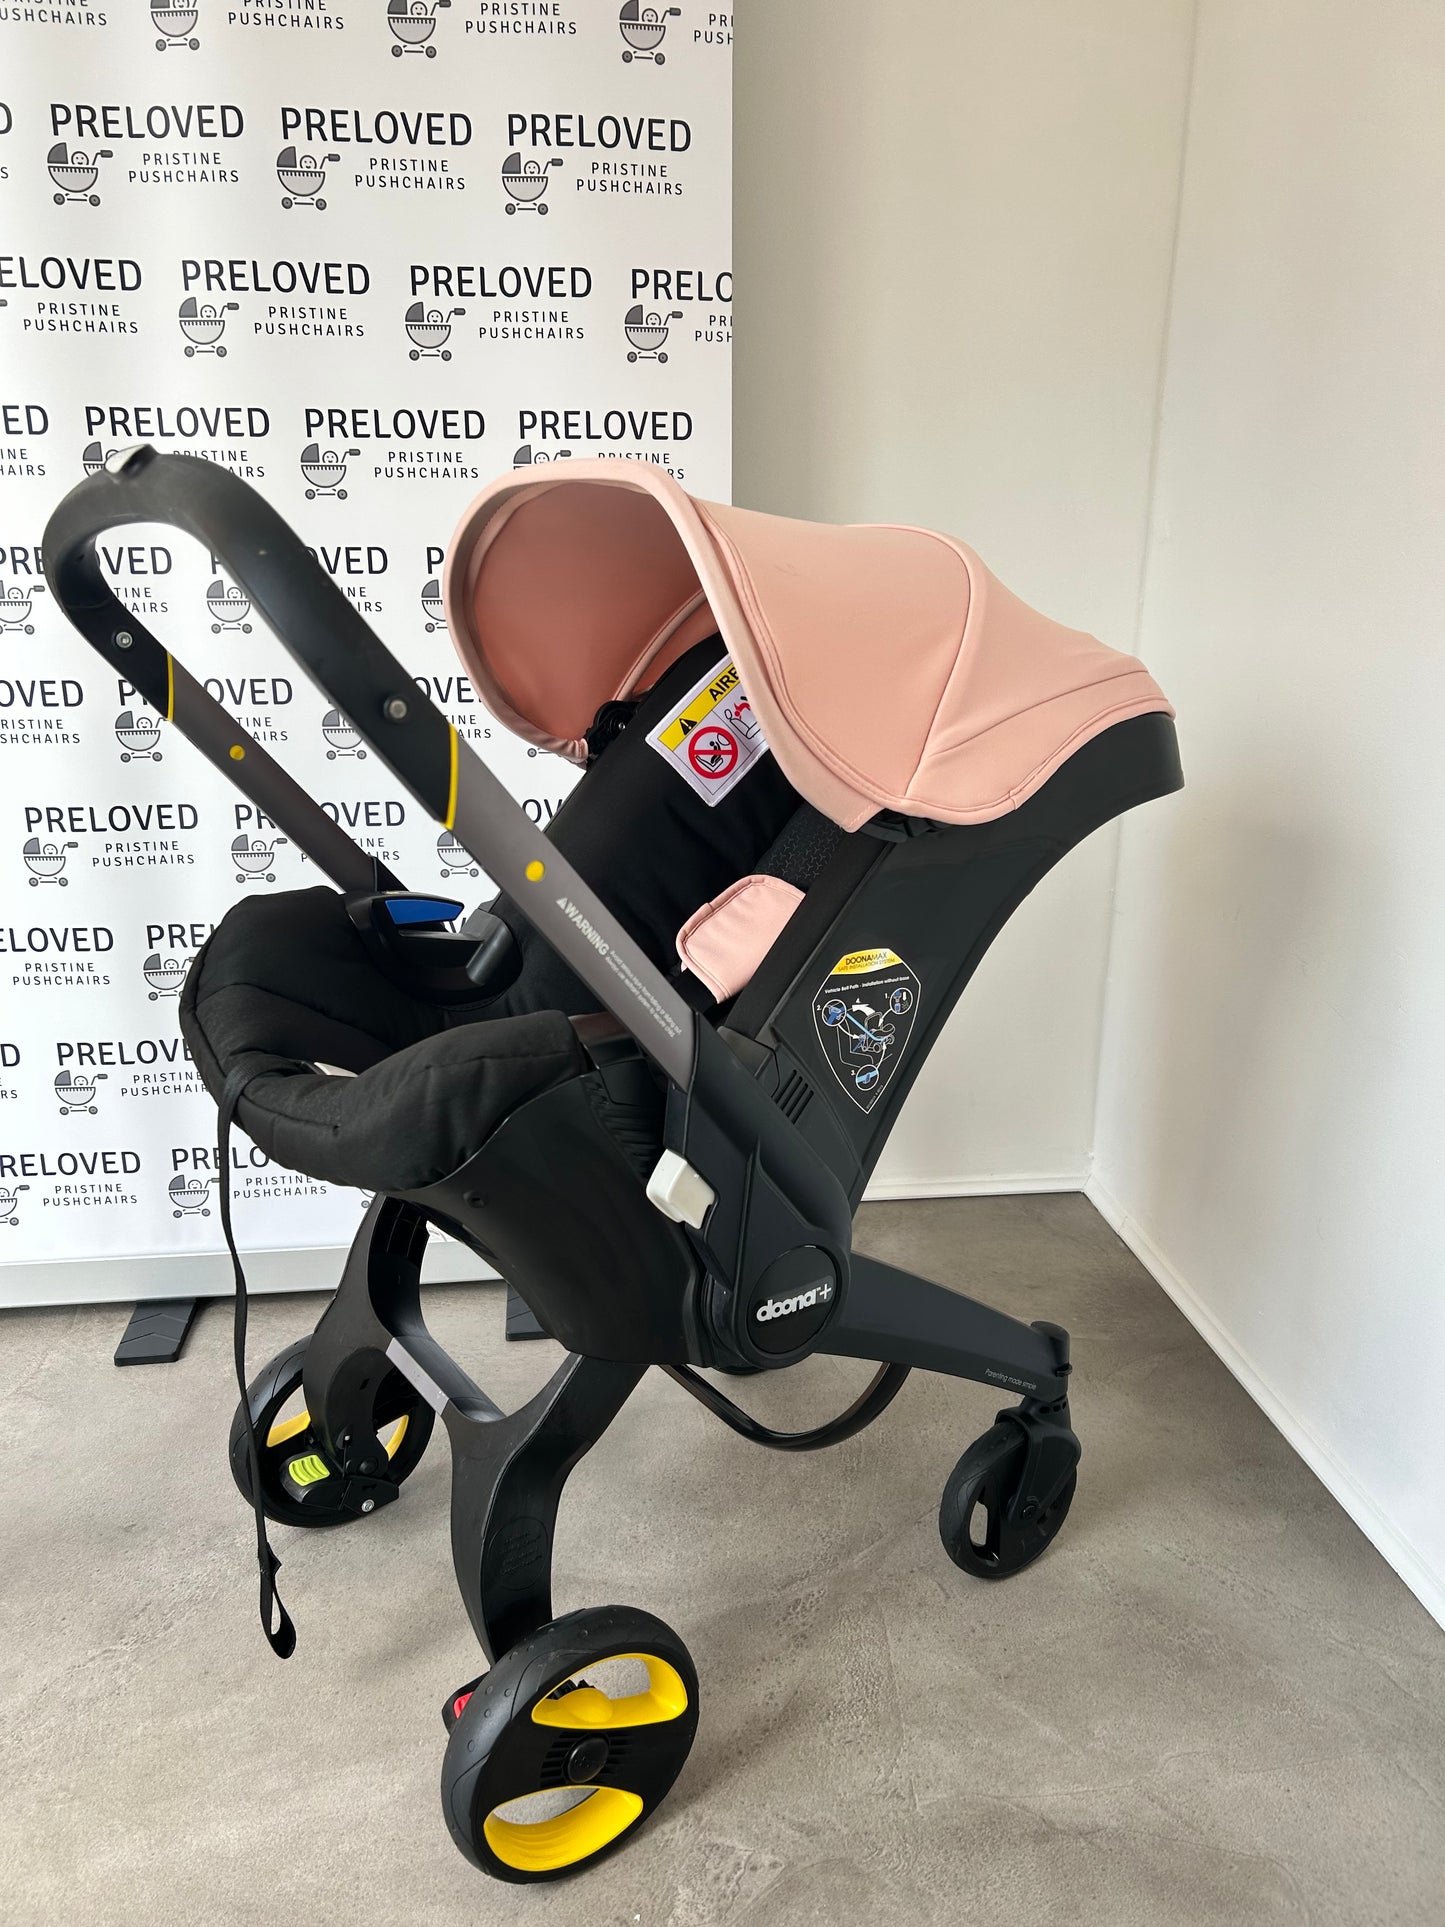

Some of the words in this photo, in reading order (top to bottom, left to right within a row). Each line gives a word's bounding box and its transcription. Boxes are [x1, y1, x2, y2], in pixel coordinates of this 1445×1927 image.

[480, 2, 561, 17] PRISTINE
[227, 11, 344, 30] PUSHCHAIRS
[465, 20, 577, 35] PUSHCHAIRS
[49, 103, 244, 139] PRELOVED
[280, 106, 472, 146] PRELOVED
[507, 113, 692, 152] PRELOVED
[142, 152, 222, 166] PRISTINE
[369, 157, 449, 173] PRISTINE
[128, 169, 239, 184] PUSHCHAIRS
[591, 161, 668, 178] PRISTINE
[354, 174, 466, 191] PUSHCHAIRS
[576, 178, 683, 196] PUSHCHAIRS
[181, 259, 370, 295] PRELOVED
[409, 264, 592, 299] PRELOVED
[37, 302, 121, 317] PRISTINE
[268, 305, 348, 320] PRISTINE
[493, 310, 569, 323] PRISTINE
[23, 318, 139, 334] PUSHCHAIRS
[253, 322, 365, 337] PUSHCHAIRS
[478, 326, 585, 340] PUSHCHAIRS
[84, 405, 270, 438] PRELOVED
[304, 408, 486, 440] PRELOVED
[518, 409, 693, 441] PRELOVED
[388, 450, 462, 464] PRISTINE
[374, 466, 479, 479] PUSHCHAIRS
[24, 803, 199, 833] PRELOVED
[104, 840, 180, 853] PRISTINE
[92, 853, 195, 868] PUSHCHAIRS
[564, 902, 610, 956] WARNING
[24, 962, 95, 973] PRISTINE
[12, 975, 111, 986] PUSHCHAIRS
[121, 1083, 209, 1097] PUSHCHAIR
[246, 1175, 313, 1187] PRISTINE
[54, 1183, 123, 1195] PRISTINE
[233, 1185, 327, 1199] PUSHCHAIRS
[42, 1194, 138, 1207] PUSHCHAIRS
